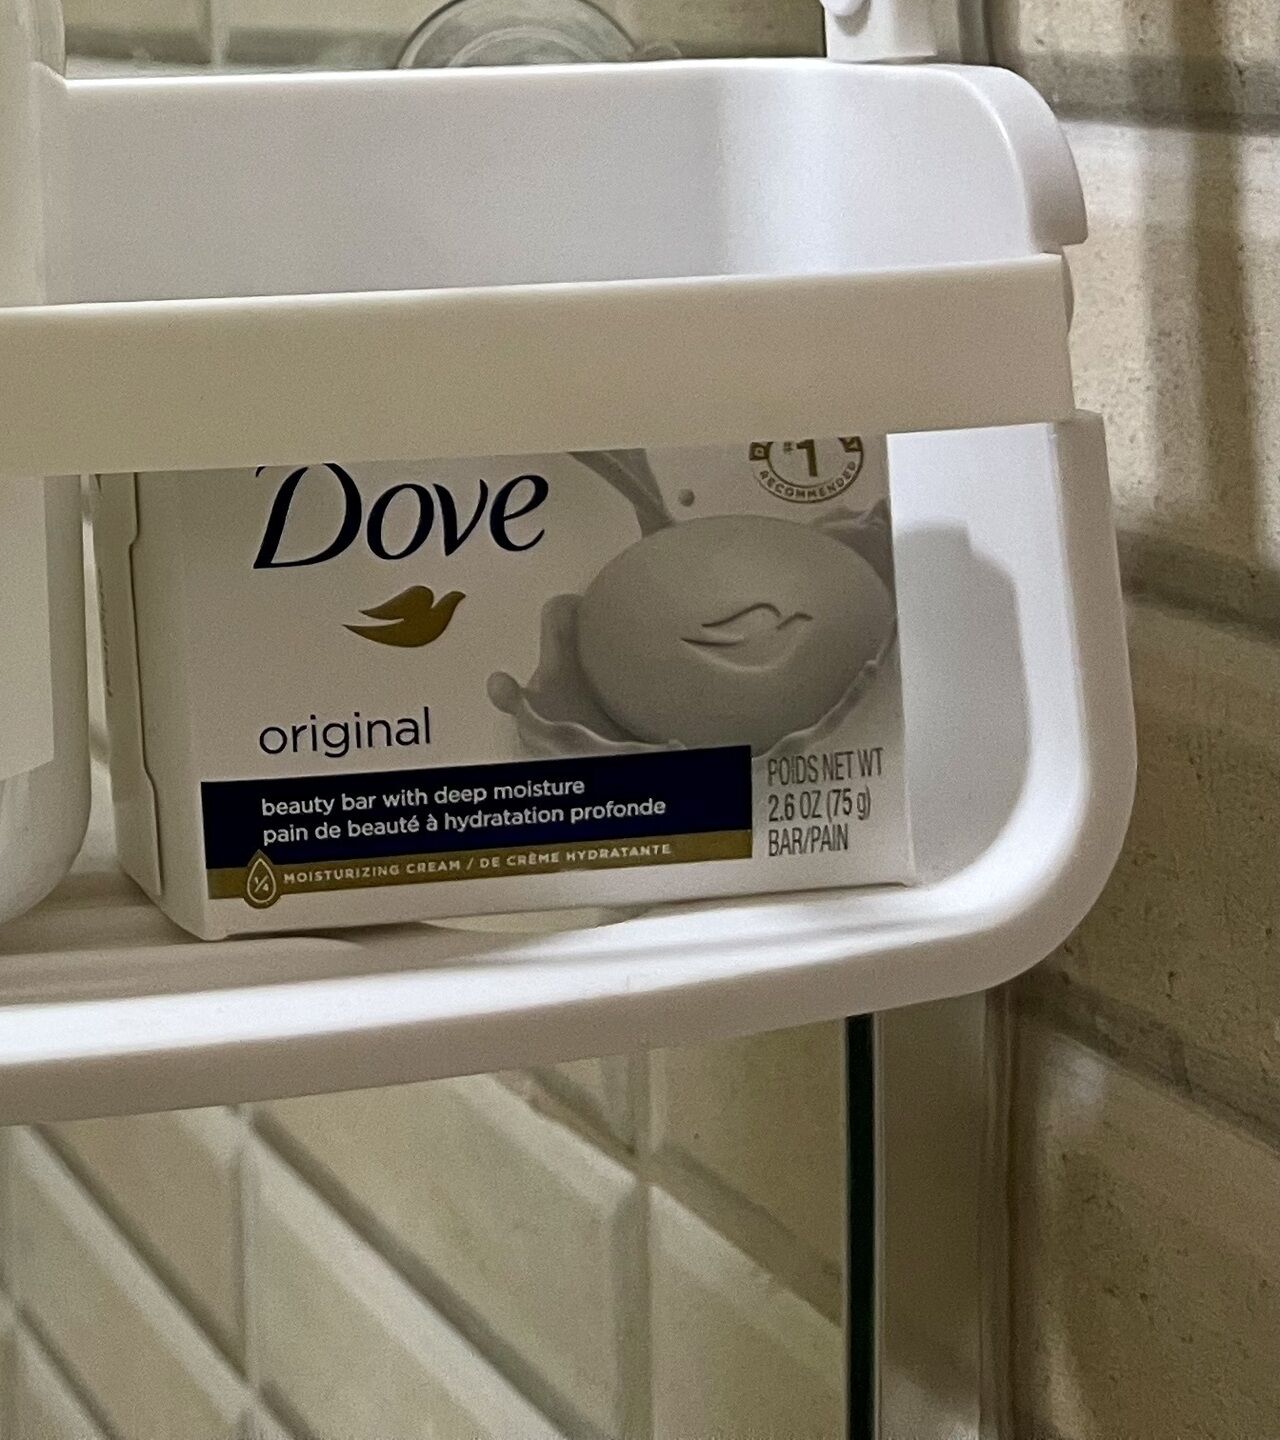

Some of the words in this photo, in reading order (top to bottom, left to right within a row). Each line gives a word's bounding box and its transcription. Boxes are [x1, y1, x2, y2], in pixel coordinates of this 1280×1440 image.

[759, 460, 856, 498] RECOMMENDED
[253, 462, 550, 570] Dove
[259, 706, 431, 758] original
[768, 754, 819, 786] POIDS
[823, 751, 854, 782] NET
[858, 747, 883, 778] WT
[261, 796, 335, 817] beauty
[341, 792, 376, 811] bar
[382, 787, 428, 808] with
[434, 785, 487, 804] deep
[493, 780, 585, 799] moisture
[768, 793, 795, 822] 2.6
[799, 790, 822, 820] OZ
[263, 823, 308, 846] pain
[314, 821, 341, 840] de
[347, 814, 420, 838] beauté
[426, 814, 438, 832] à
[444, 806, 565, 833] hydratation
[570, 798, 667, 824] profonde
[768, 823, 849, 857] BAR/PAIN
[283, 864, 400, 885] MOISTURIZING
[406, 860, 461, 875] CREAM
[479, 856, 501, 869] DE
[506, 851, 560, 867] CRÈME
[566, 844, 672, 862] HYDRATANTE
